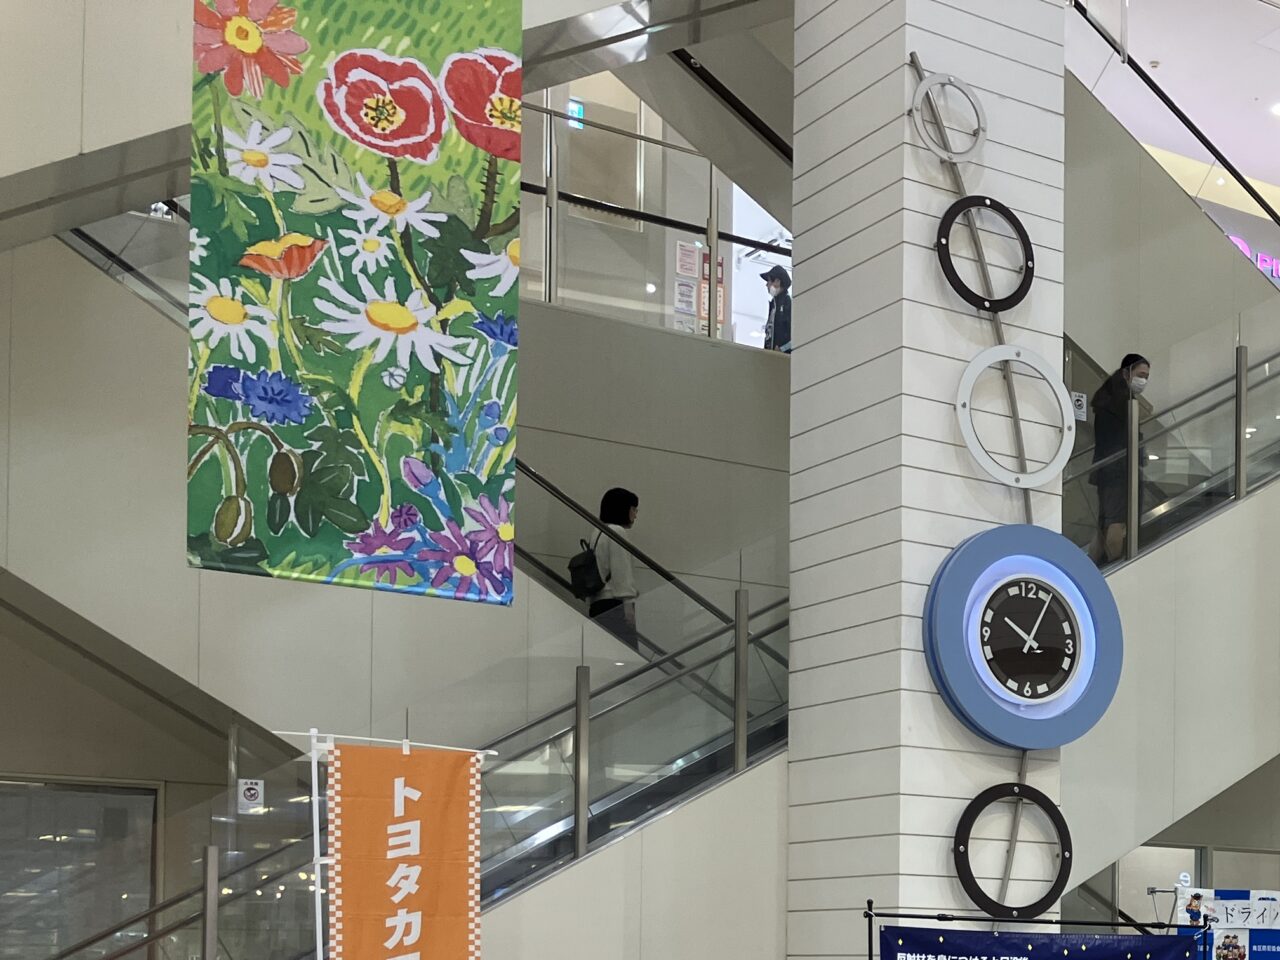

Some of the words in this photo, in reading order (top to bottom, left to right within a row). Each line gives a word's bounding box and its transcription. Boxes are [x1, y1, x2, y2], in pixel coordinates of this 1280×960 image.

[1020, 582, 1037, 599] 12
[982, 627, 991, 641] 9
[1065, 640, 1074, 654] 3
[1024, 682, 1032, 696] 6
